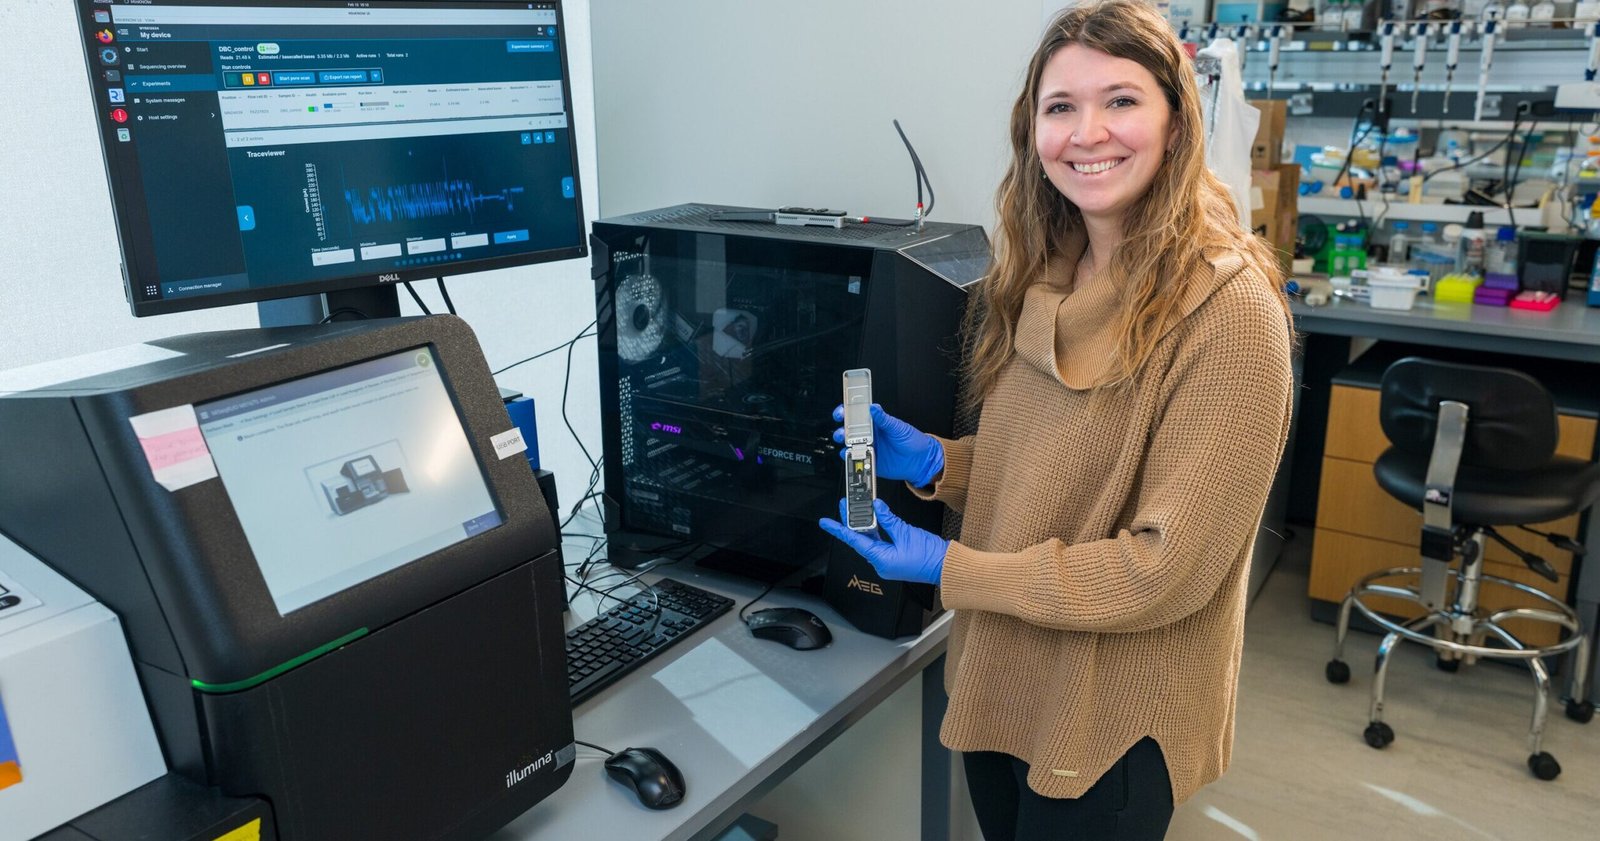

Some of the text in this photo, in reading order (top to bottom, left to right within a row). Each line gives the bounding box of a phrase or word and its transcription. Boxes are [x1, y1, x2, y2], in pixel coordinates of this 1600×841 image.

[247, 150, 285, 158] Traceviewer
[663, 425, 681, 434] msi
[496, 437, 521, 450] USB PORT
[795, 454, 812, 464] RTX
[847, 574, 884, 595] MEG
